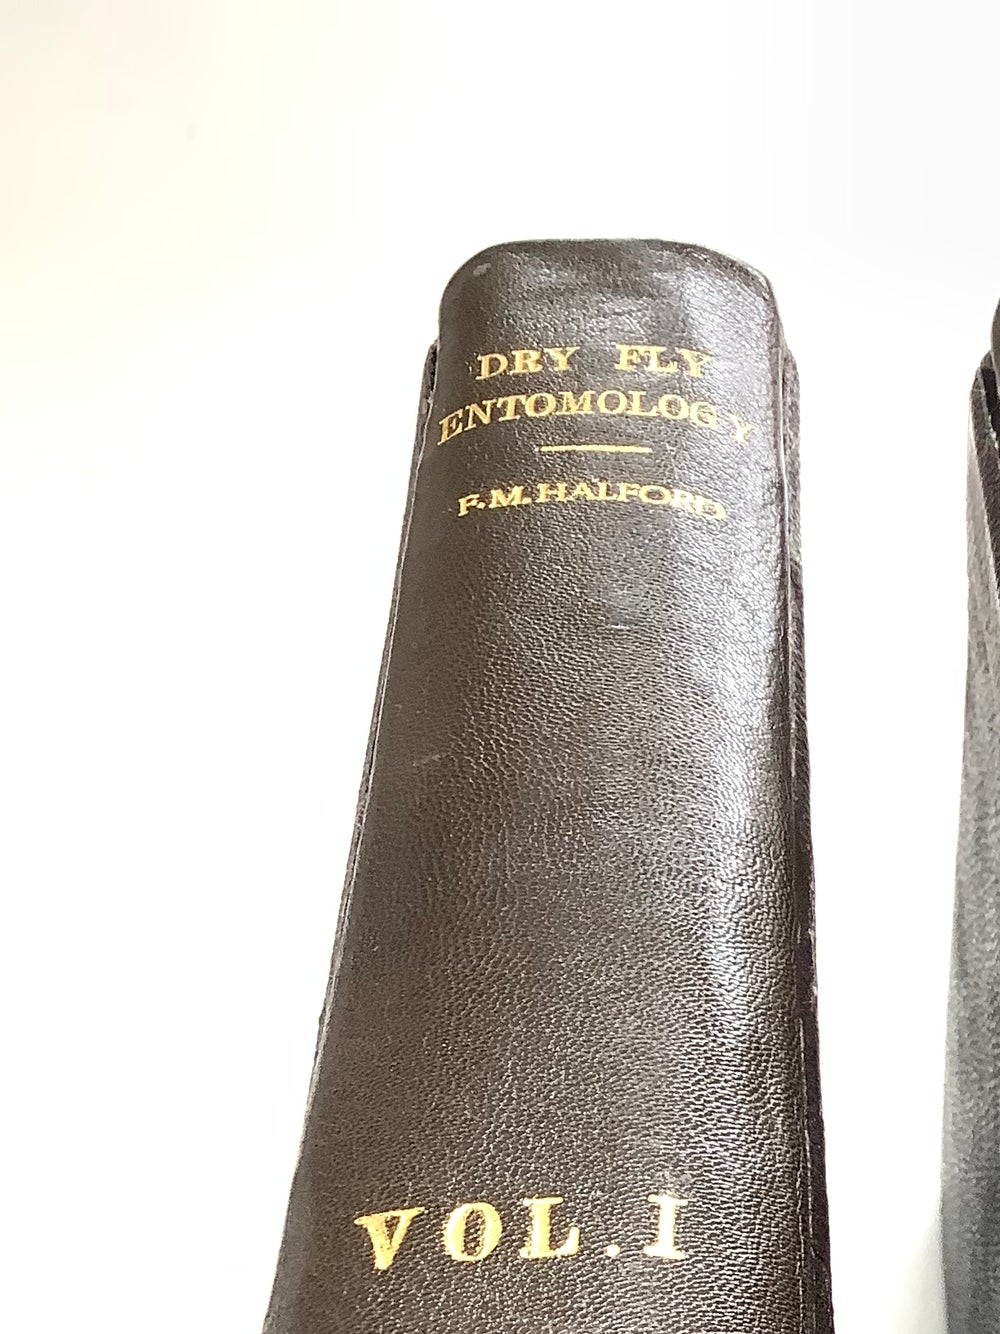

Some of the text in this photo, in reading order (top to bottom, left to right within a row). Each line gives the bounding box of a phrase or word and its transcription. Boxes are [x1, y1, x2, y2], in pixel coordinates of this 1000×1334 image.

[475, 344, 713, 380] DRY FLY
[437, 390, 756, 446] ENTOMOLOGY
